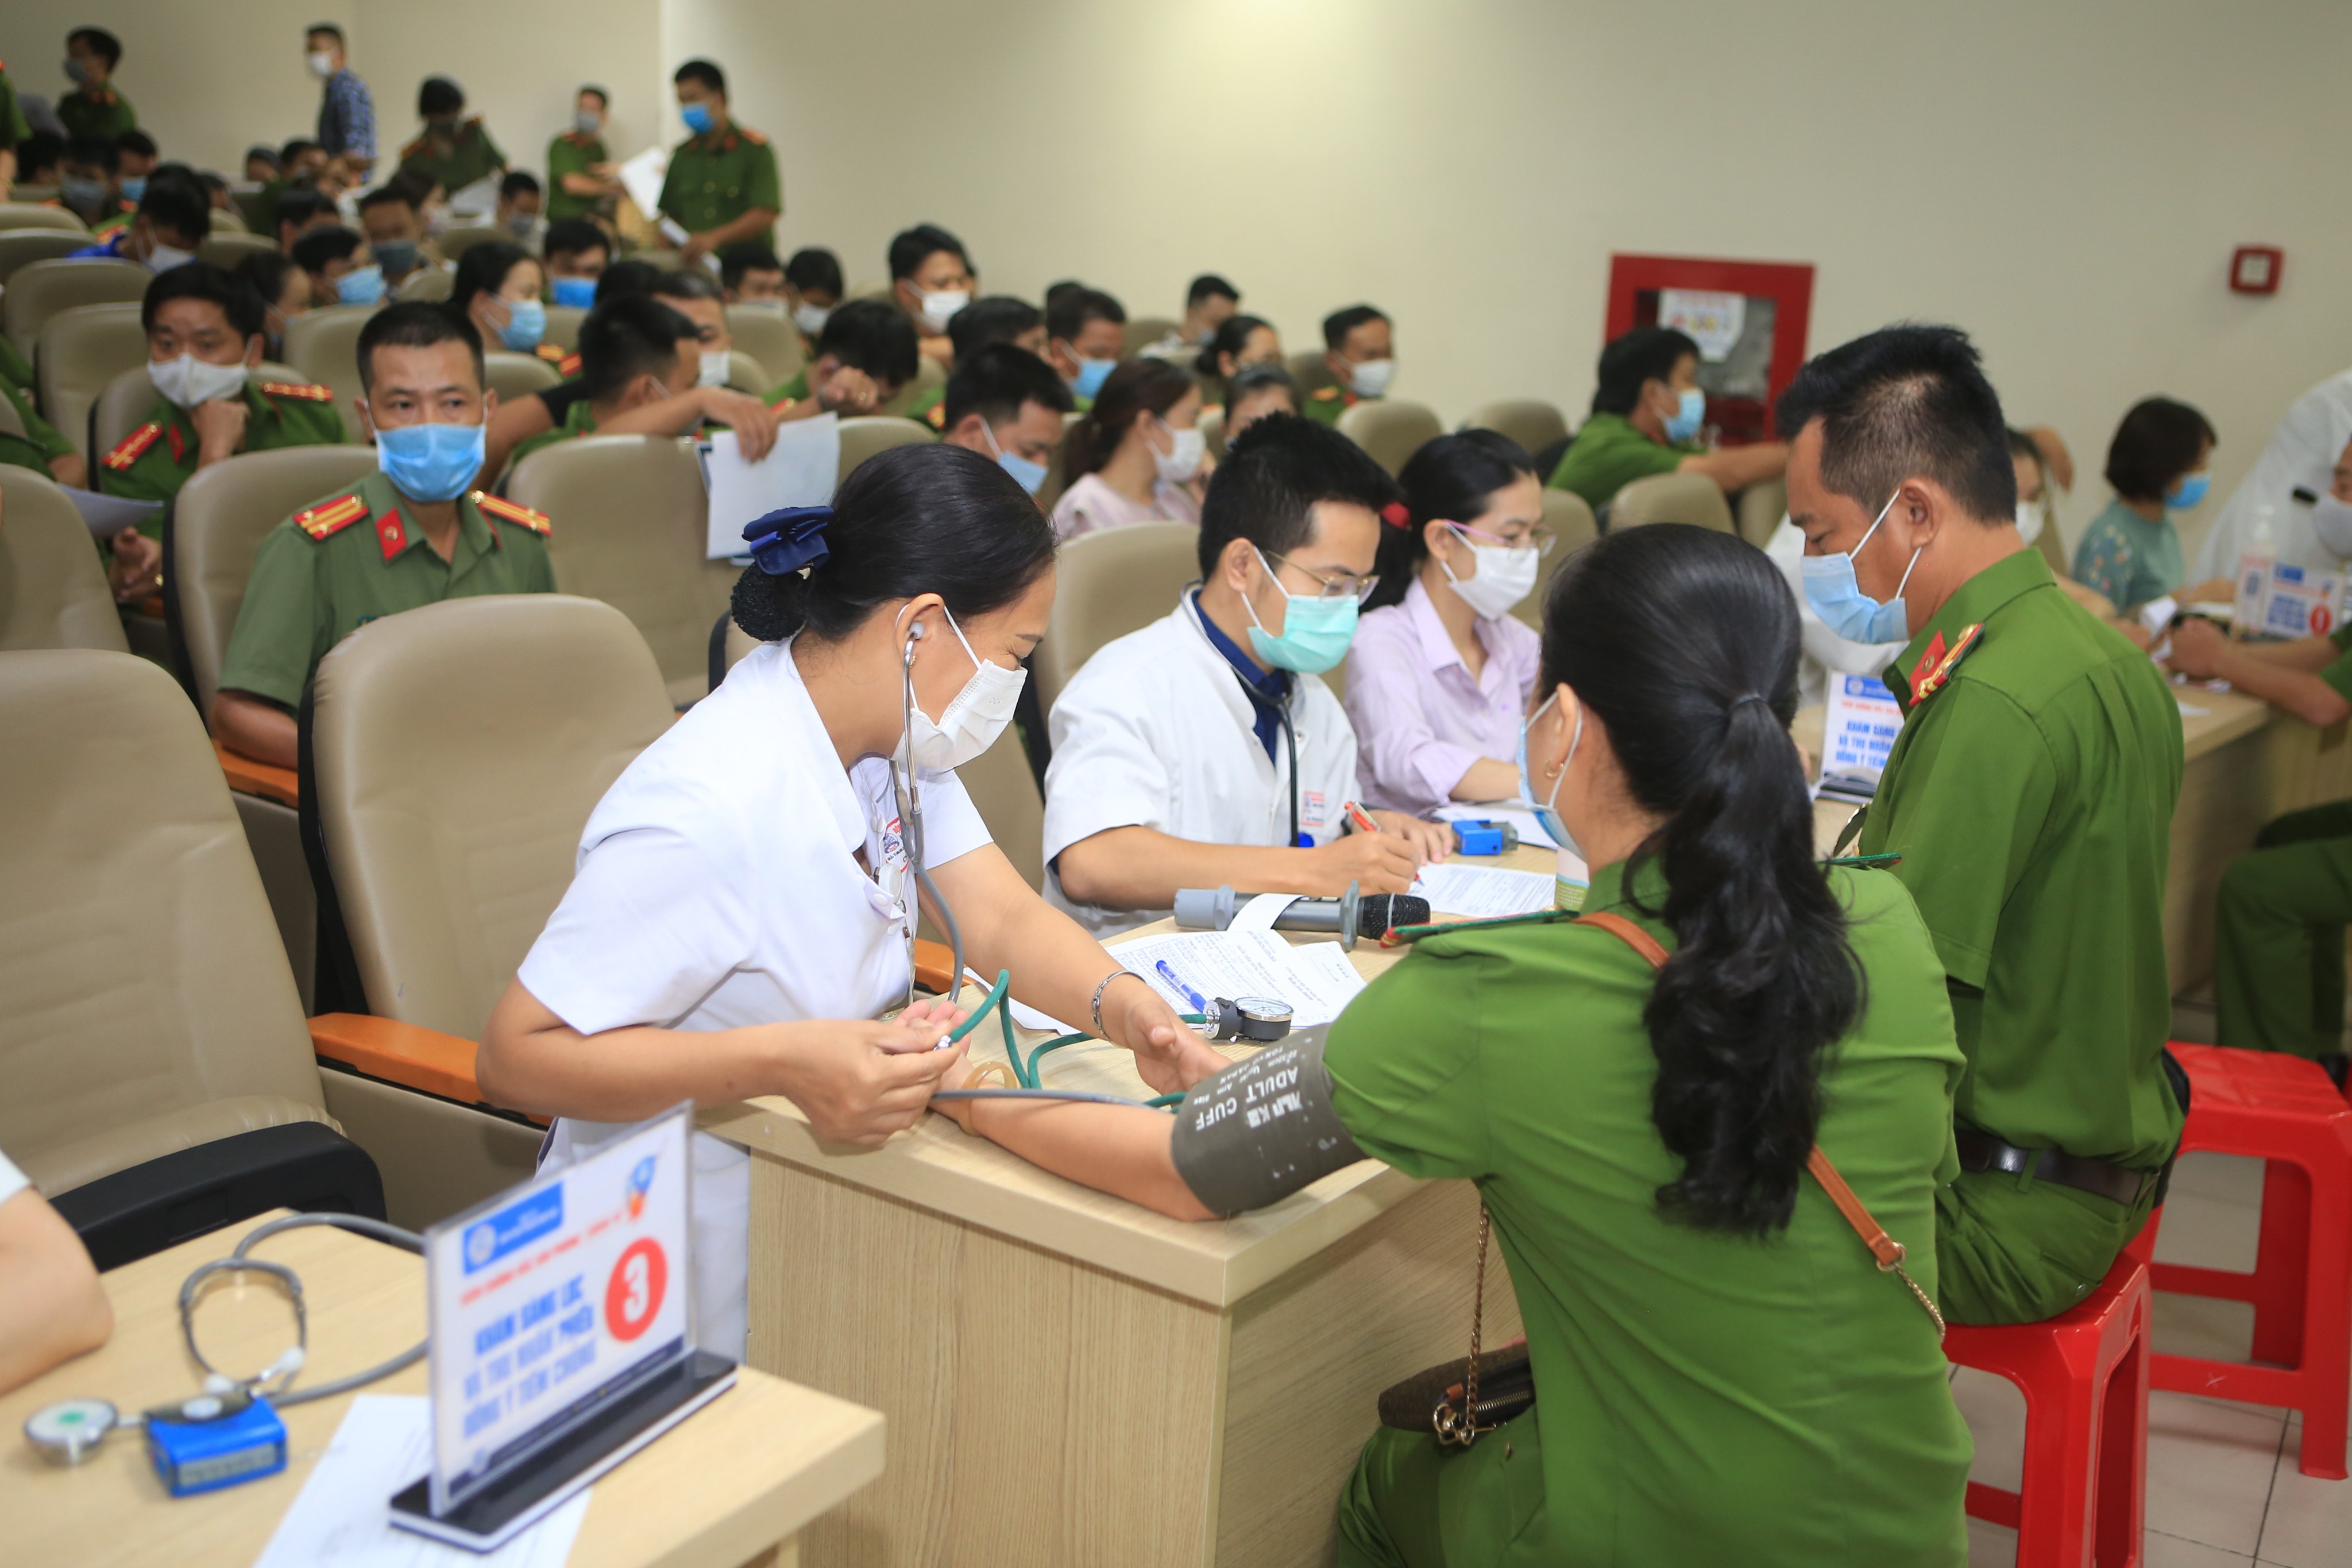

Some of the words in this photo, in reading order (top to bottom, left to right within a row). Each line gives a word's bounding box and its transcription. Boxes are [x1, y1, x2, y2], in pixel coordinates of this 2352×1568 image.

[1246, 1066, 1298, 1103] ADULT
[1196, 1097, 1237, 1131] CUFF
[623, 1252, 650, 1326] 3
